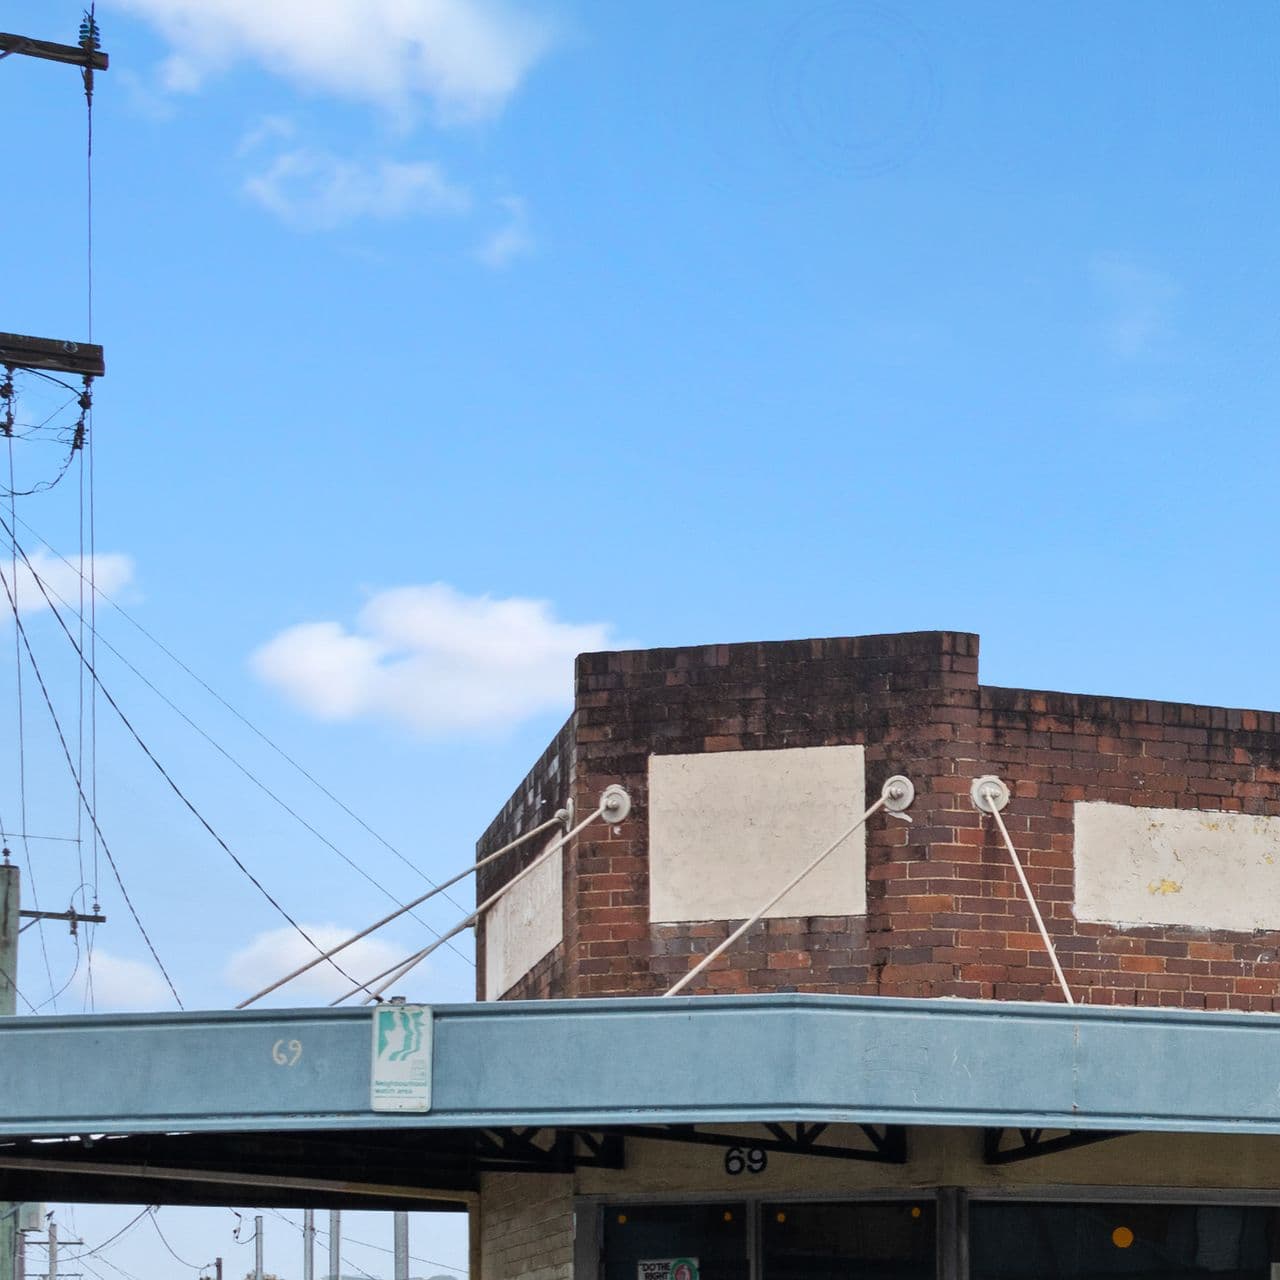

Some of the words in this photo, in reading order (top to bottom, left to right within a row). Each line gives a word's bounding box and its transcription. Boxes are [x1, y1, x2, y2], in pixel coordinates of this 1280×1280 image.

[272, 1039, 303, 1066] 69
[724, 1147, 768, 1175] 69
[644, 1271, 669, 1280] RIGHT
